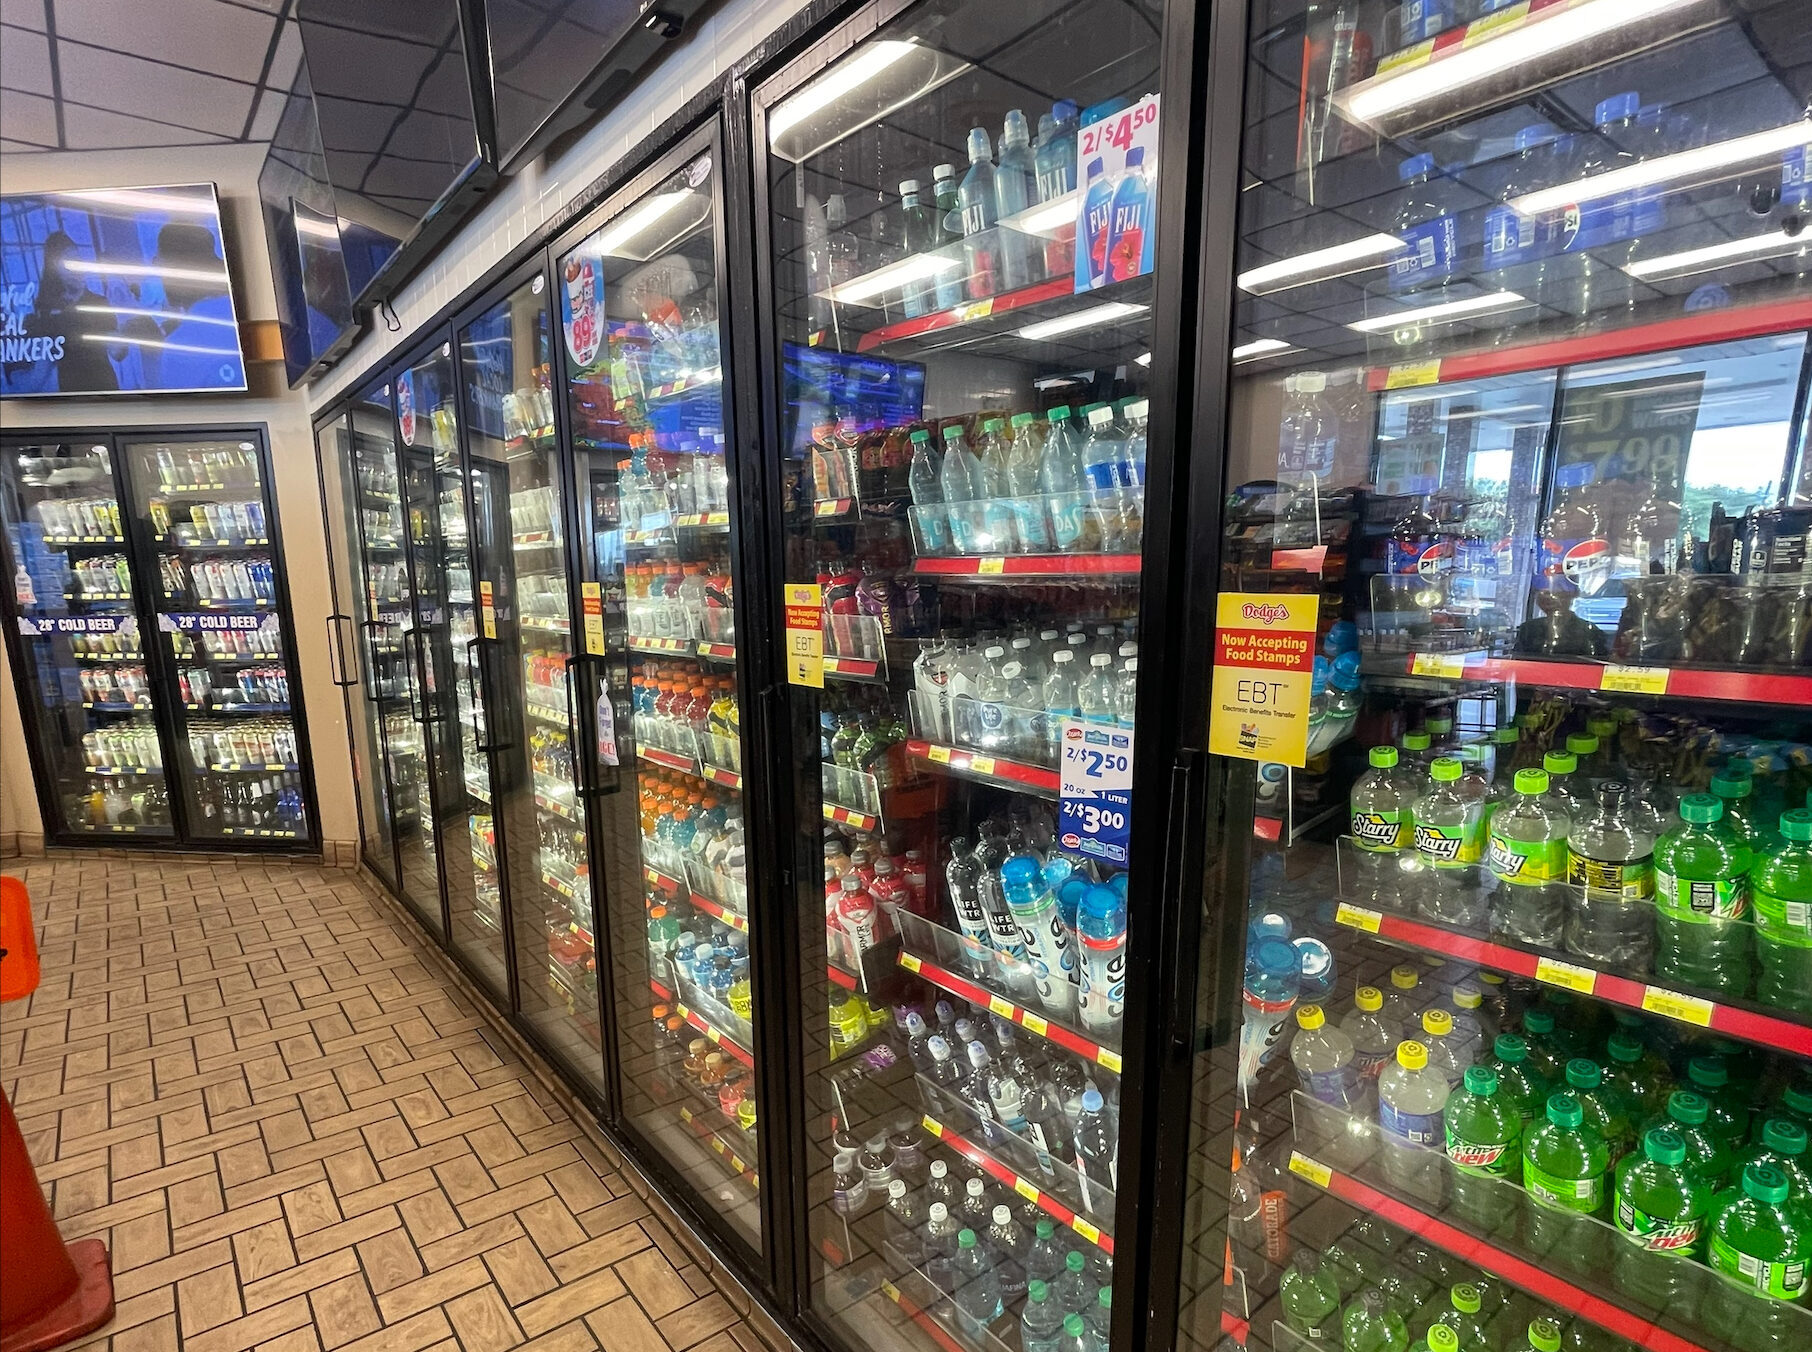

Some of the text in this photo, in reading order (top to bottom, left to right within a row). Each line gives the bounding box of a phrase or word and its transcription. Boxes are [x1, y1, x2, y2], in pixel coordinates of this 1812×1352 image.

[961, 204, 986, 237] FIJI
[1115, 204, 1141, 233] FIJI
[58, 618, 87, 631] COLD
[88, 617, 117, 631] BEER
[198, 616, 230, 629] COLD
[229, 616, 258, 629] BEER
[1242, 603, 1290, 625] Dodge's
[1222, 633, 1308, 653] Now Accepting
[1226, 648, 1301, 666] Food Stamps
[1237, 680, 1283, 705] EBT
[1064, 783, 1074, 793] 20
[1101, 791, 1129, 805] 1 LITER
[1353, 812, 1400, 844] Starry
[1414, 826, 1461, 859] Starry
[1264, 1198, 1280, 1258] GATORADE
